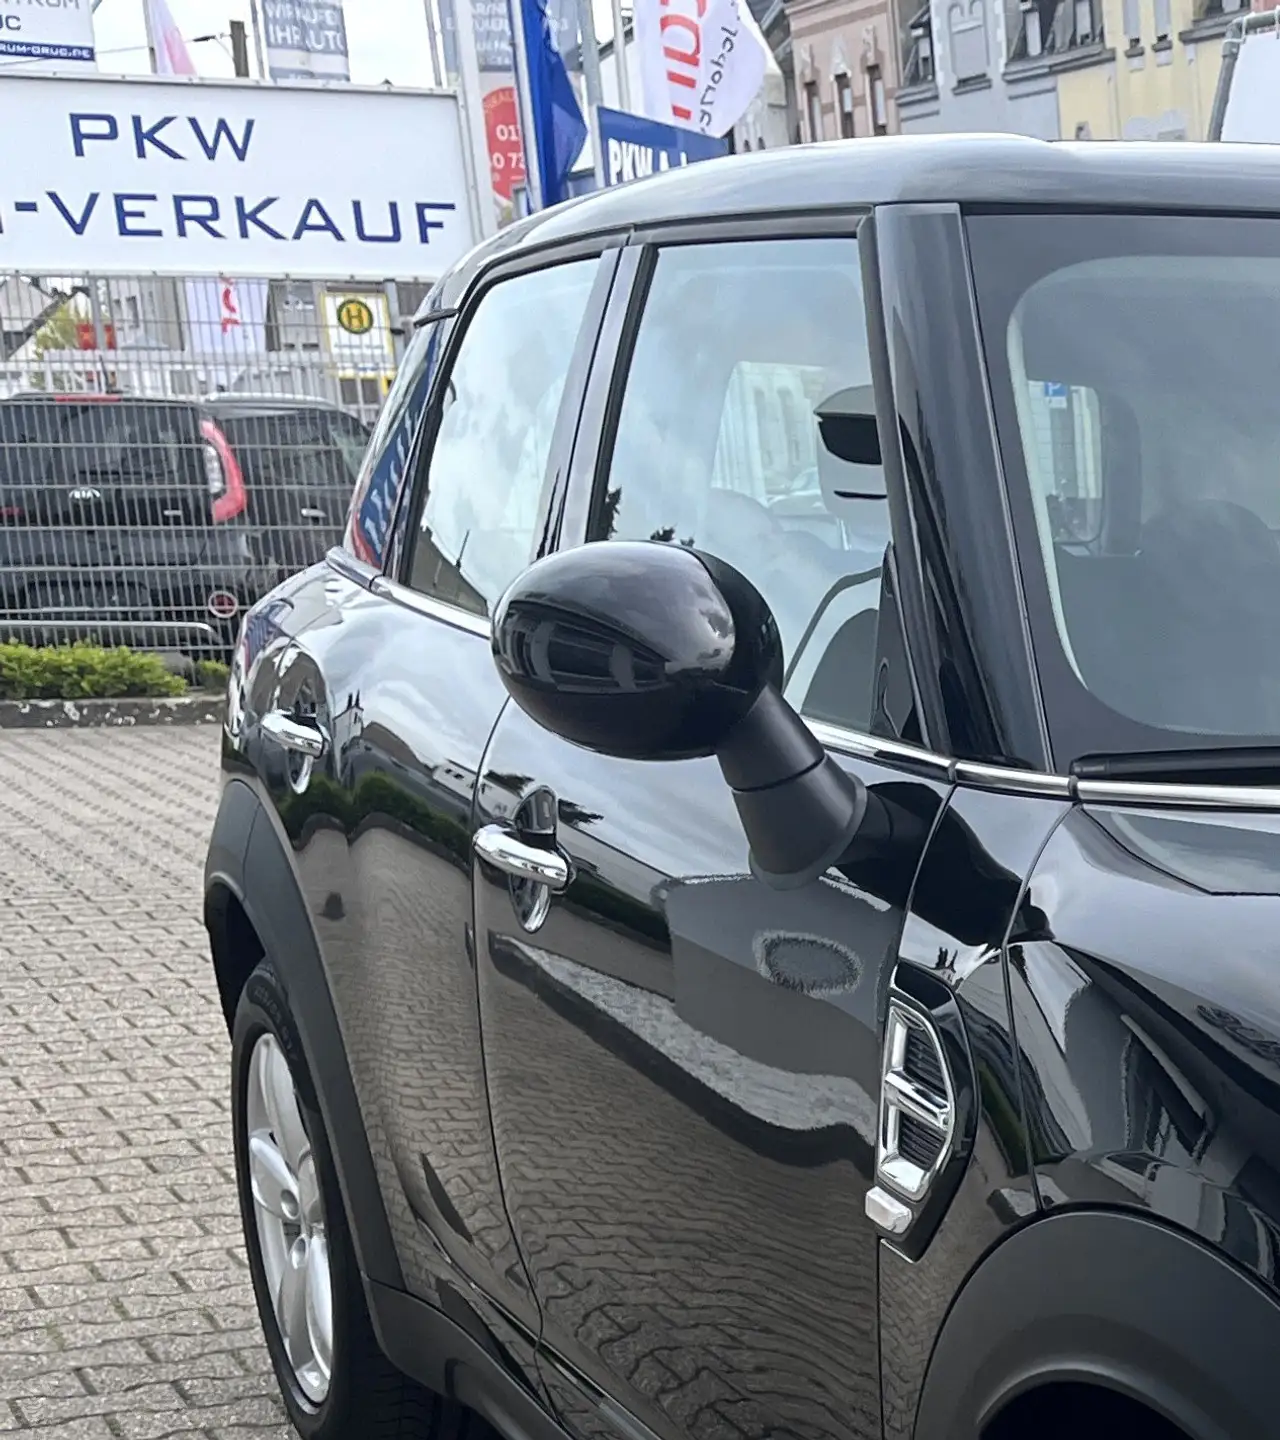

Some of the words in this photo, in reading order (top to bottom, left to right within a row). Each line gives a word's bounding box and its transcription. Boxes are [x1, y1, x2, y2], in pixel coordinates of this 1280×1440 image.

[69, 113, 255, 162] PKW
[608, 138, 653, 186] PKW
[0, 191, 456, 244] -VERKAUF
